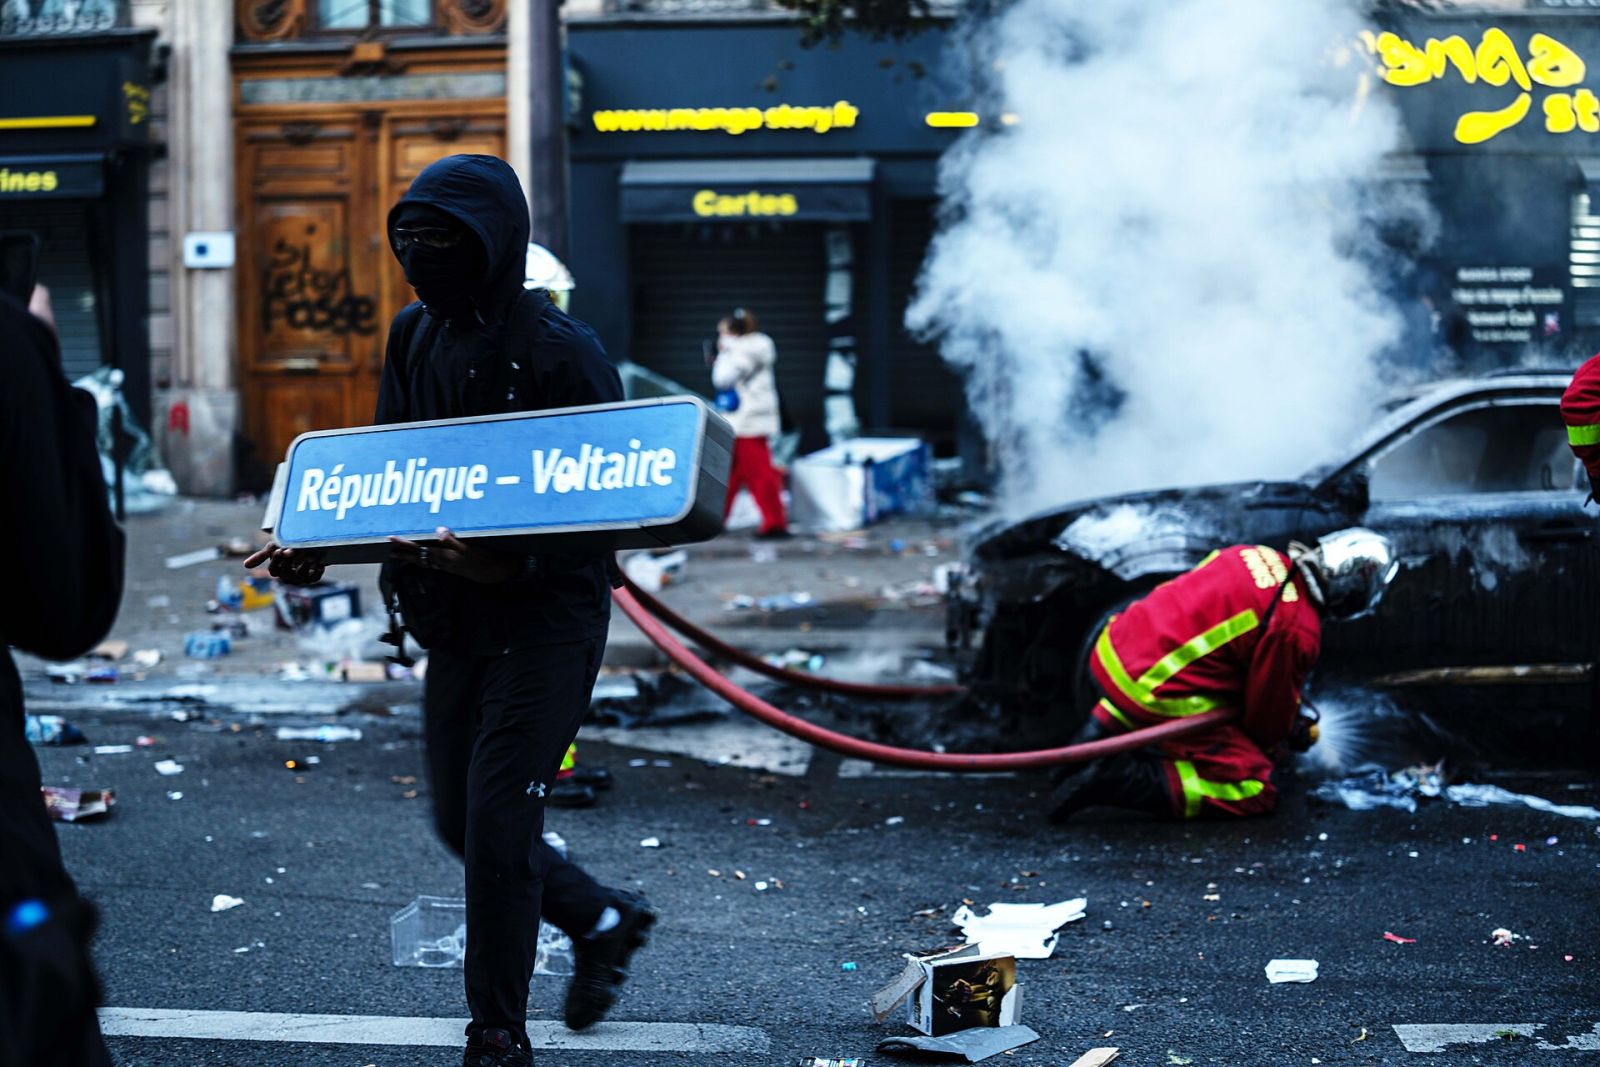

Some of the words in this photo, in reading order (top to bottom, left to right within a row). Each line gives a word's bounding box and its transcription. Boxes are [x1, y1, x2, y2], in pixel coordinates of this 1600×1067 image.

[693, 189, 798, 217] Cartes
[297, 457, 488, 520] République
[532, 438, 676, 494] Voltaire
